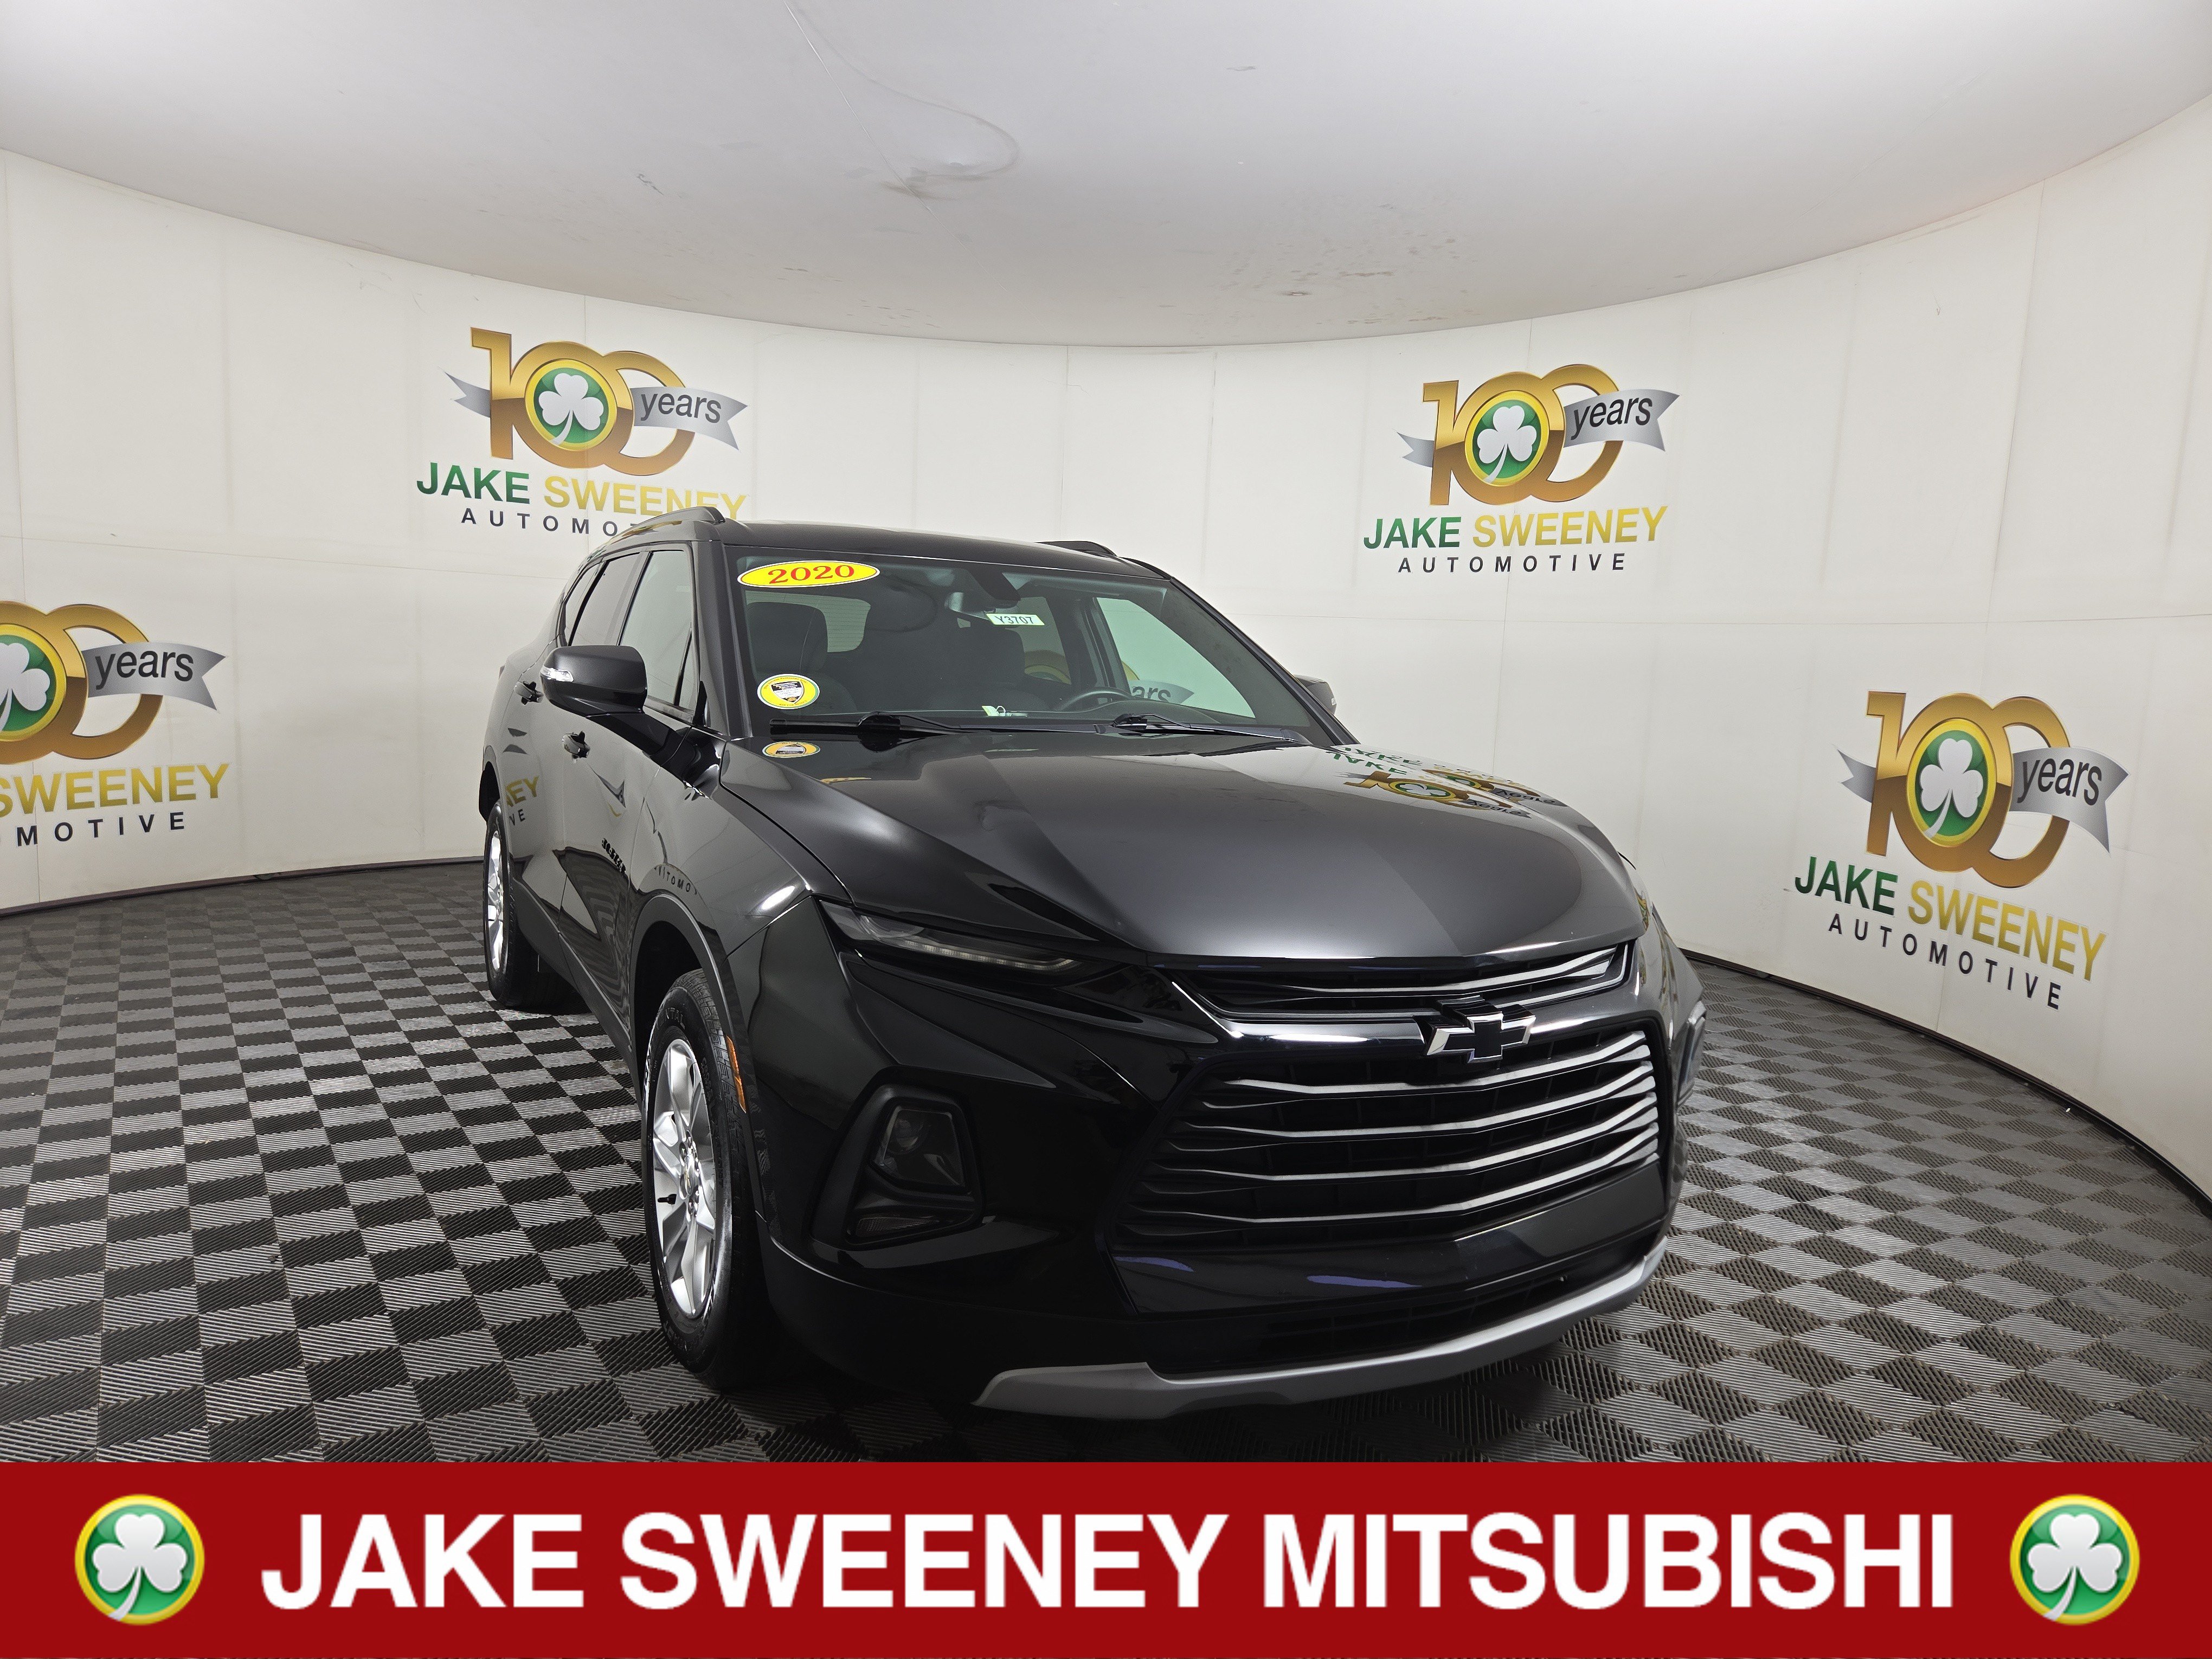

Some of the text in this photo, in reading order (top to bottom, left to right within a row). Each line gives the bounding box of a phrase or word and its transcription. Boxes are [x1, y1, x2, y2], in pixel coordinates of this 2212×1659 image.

[471, 327, 722, 475] 100 years
[1422, 364, 1653, 506] 100 years
[416, 462, 530, 504] JAKE
[461, 507, 641, 536] AUTOMO
[1364, 506, 1669, 549] JAKE SWEENEY
[768, 565, 855, 584] 2020
[1398, 553, 1625, 573] AUTOMOTIVE
[994, 616, 1034, 624] Y3707
[95, 650, 194, 690] years
[1866, 691, 2102, 888] 100 years
[1795, 856, 2107, 982] JAKE SWEENEY
[1828, 913, 2062, 1011] AUTOMOTIVE
